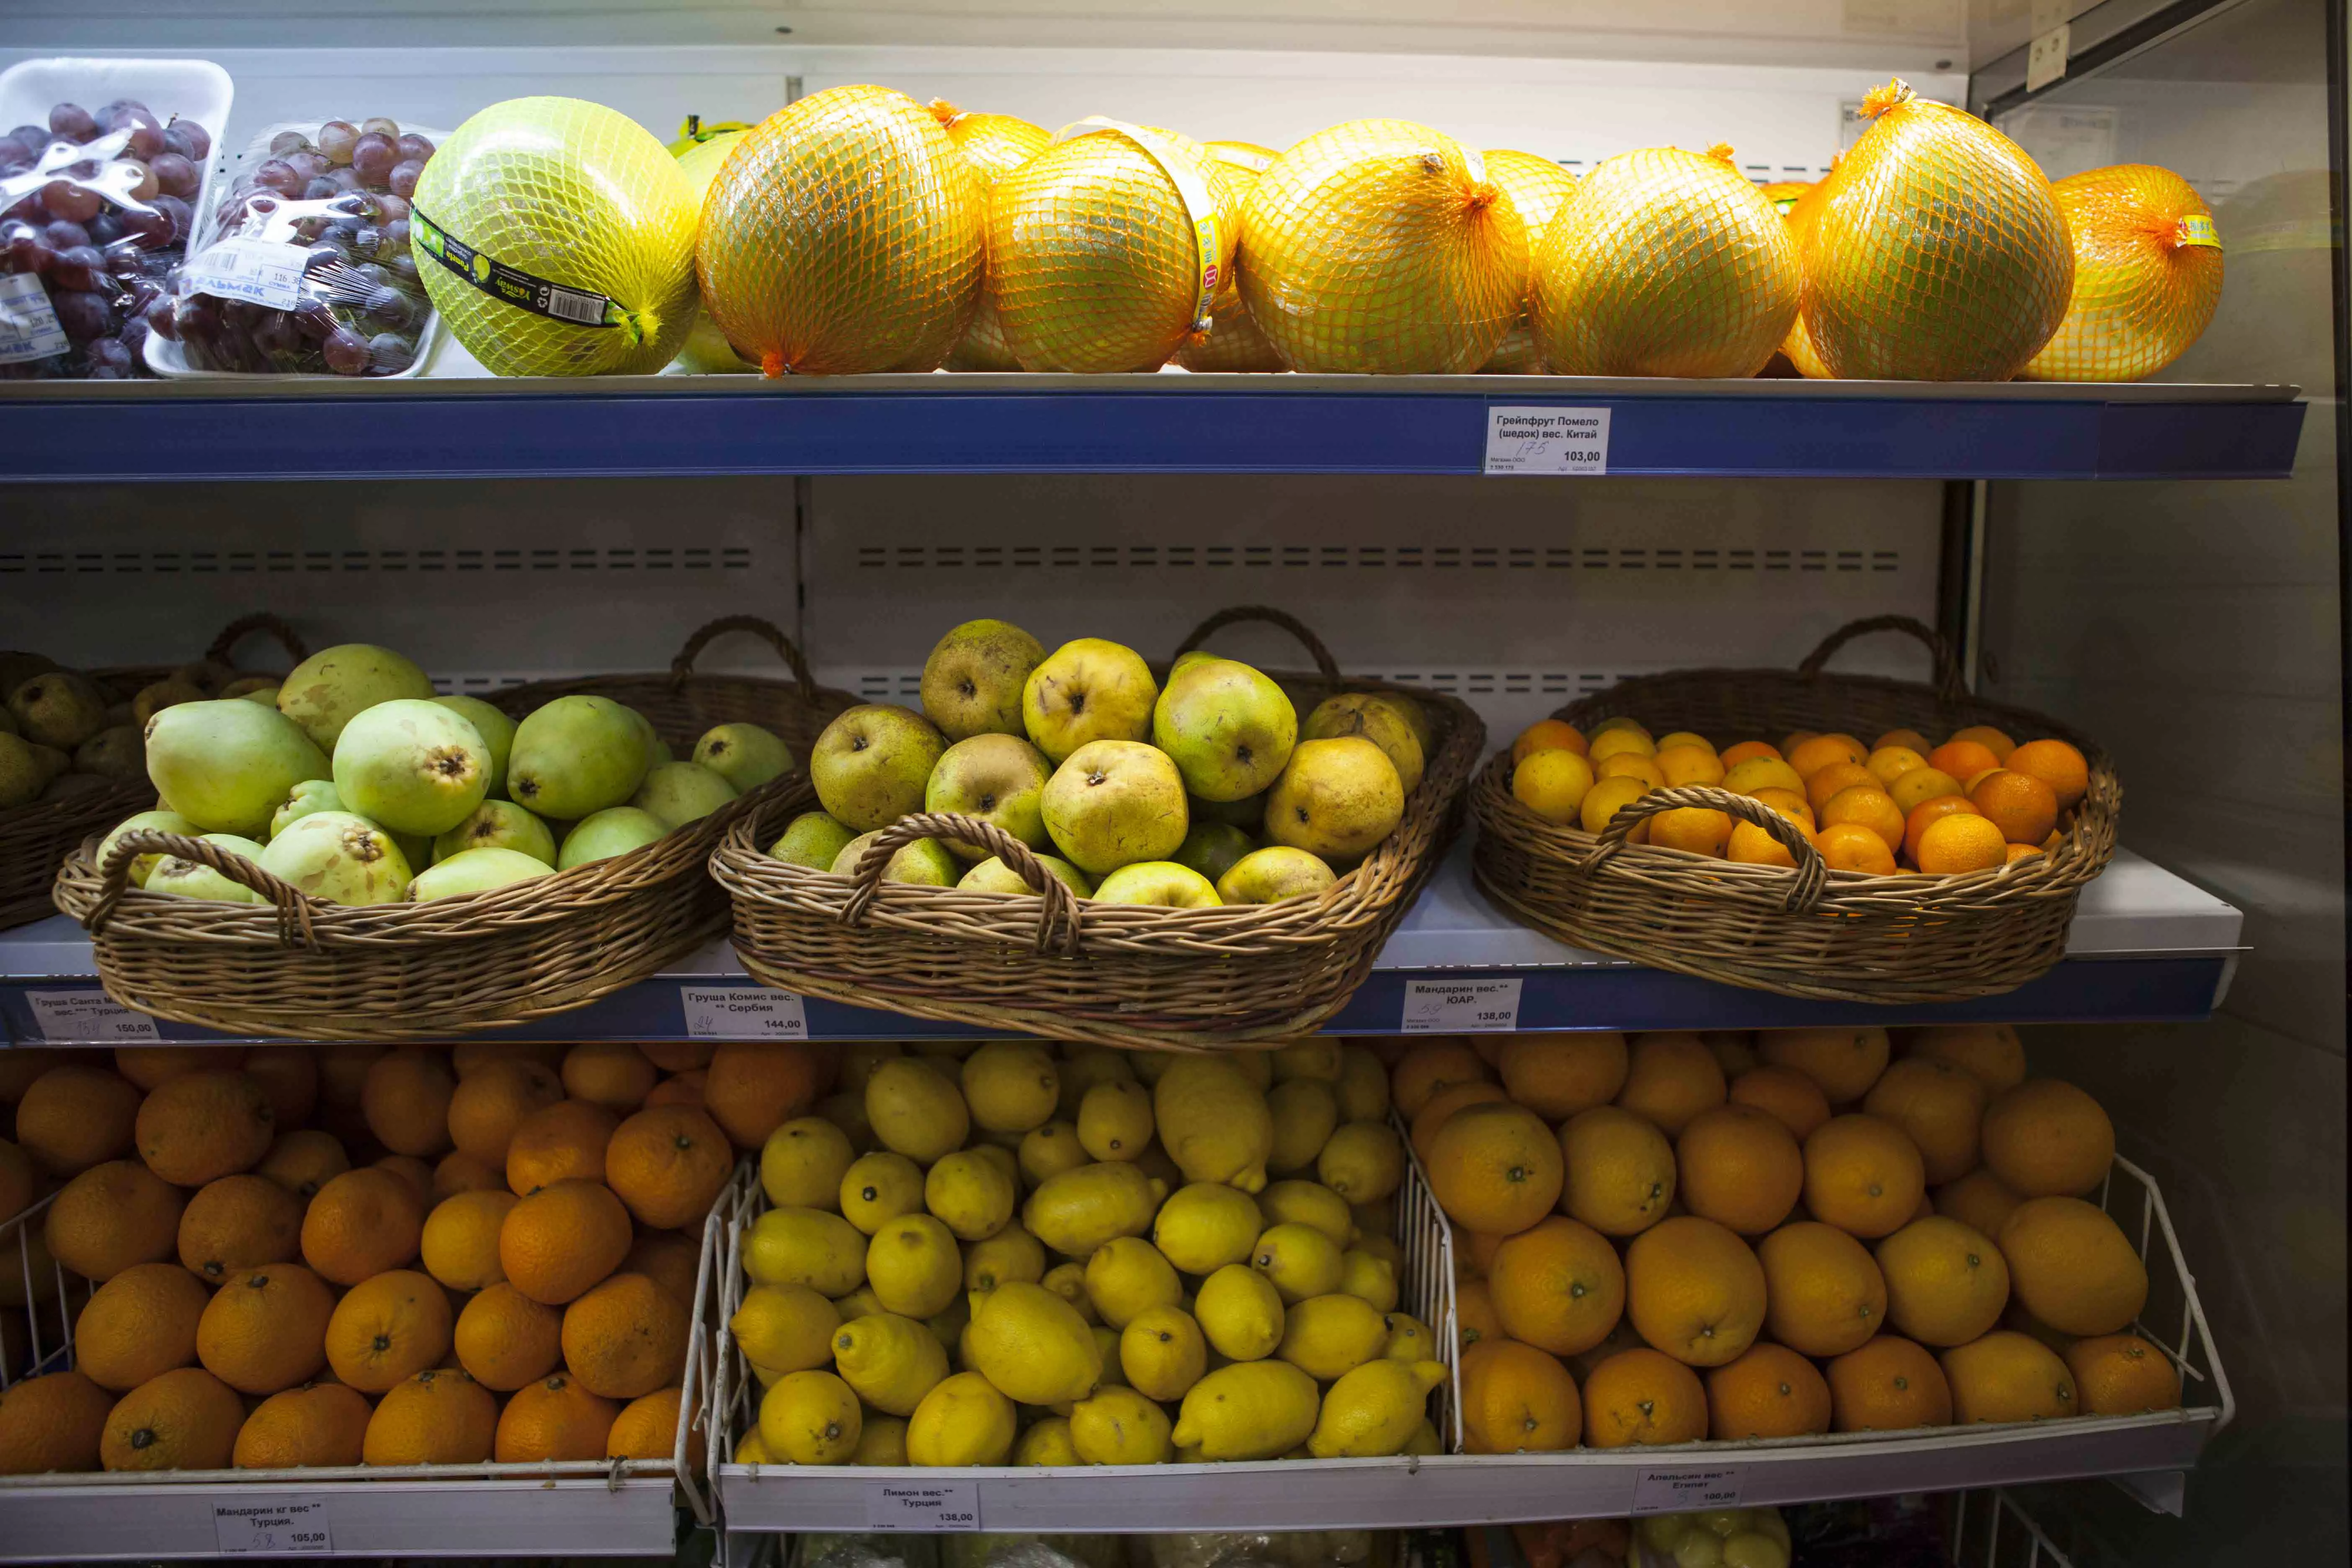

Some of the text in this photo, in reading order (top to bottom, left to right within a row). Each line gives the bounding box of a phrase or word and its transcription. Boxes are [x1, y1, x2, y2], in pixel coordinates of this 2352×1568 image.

[446, 250, 469, 272] Pomelo
[1497, 415, 1599, 427] Грейпфрут Помело
[1499, 429, 1539, 439] (шедок)
[1567, 430, 1597, 438] Китай
[1516, 441, 1549, 457] 175
[1564, 451, 1600, 463] 103,00
[1416, 985, 1473, 994] Мандарин
[36, 998, 67, 1007] Груша
[688, 993, 726, 1003] Груша
[1447, 995, 1477, 1004] ЮАР.
[92, 1008, 129, 1016] Турция
[729, 1004, 773, 1013] Сербия
[1477, 1012, 1511, 1021] 138,00
[116, 1024, 152, 1033] 150,00
[764, 1020, 801, 1029] 144,00
[1704, 1492, 1736, 1501] 100,00
[902, 1499, 942, 1508] Турция
[939, 1514, 973, 1522] 138,00
[250, 1518, 294, 1528] Турция.
[291, 1533, 325, 1542] 105,00
